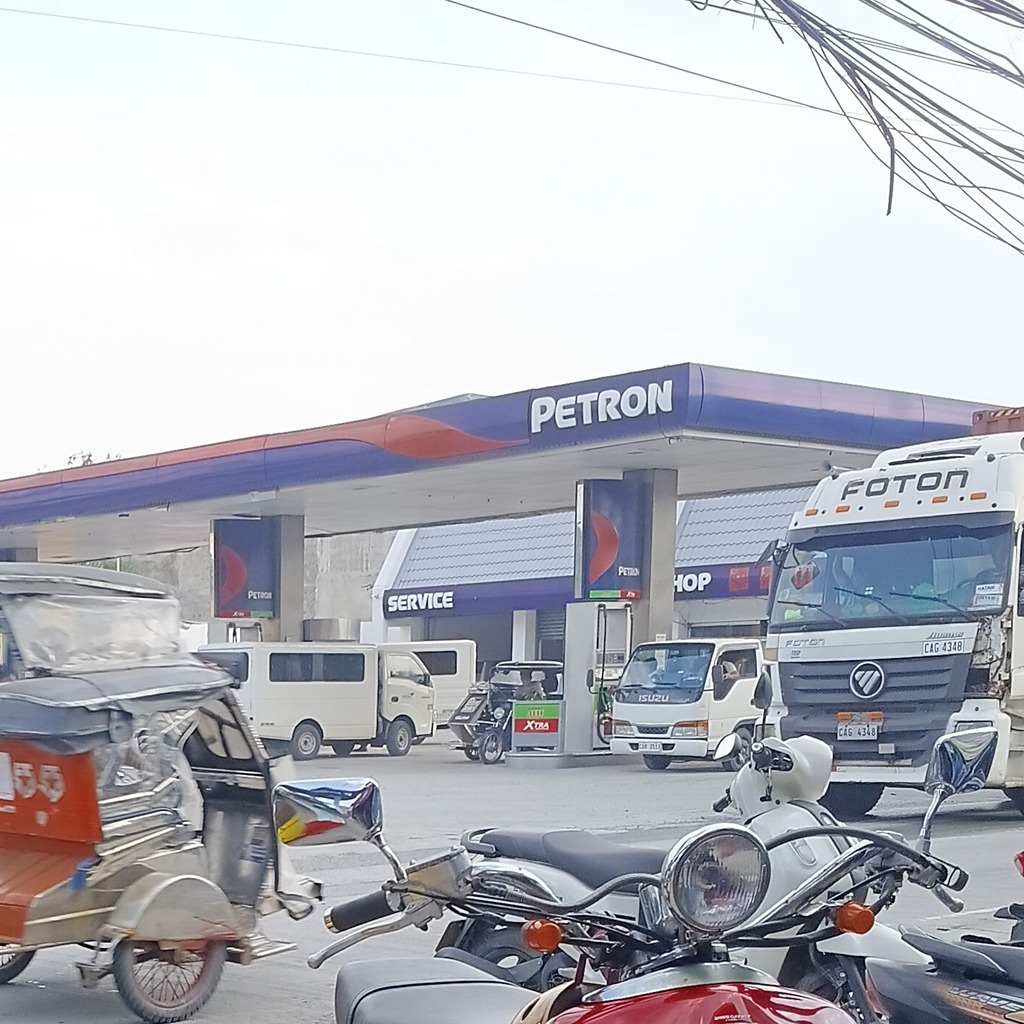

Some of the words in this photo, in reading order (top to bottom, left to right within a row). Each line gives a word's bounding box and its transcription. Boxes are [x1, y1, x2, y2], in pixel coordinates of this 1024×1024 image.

[531, 379, 673, 434] PETRON
[840, 470, 969, 501] FOTON
[674, 572, 712, 593] HOP
[247, 590, 273, 600] PETRON
[387, 591, 454, 613] SERVICE
[924, 642, 940, 654] CAG
[942, 640, 963, 653] 4348
[638, 694, 669, 703] ISUZU
[522, 720, 550, 731] XTRA
[838, 727, 853, 737] CAG
[857, 727, 876, 737] 4348
